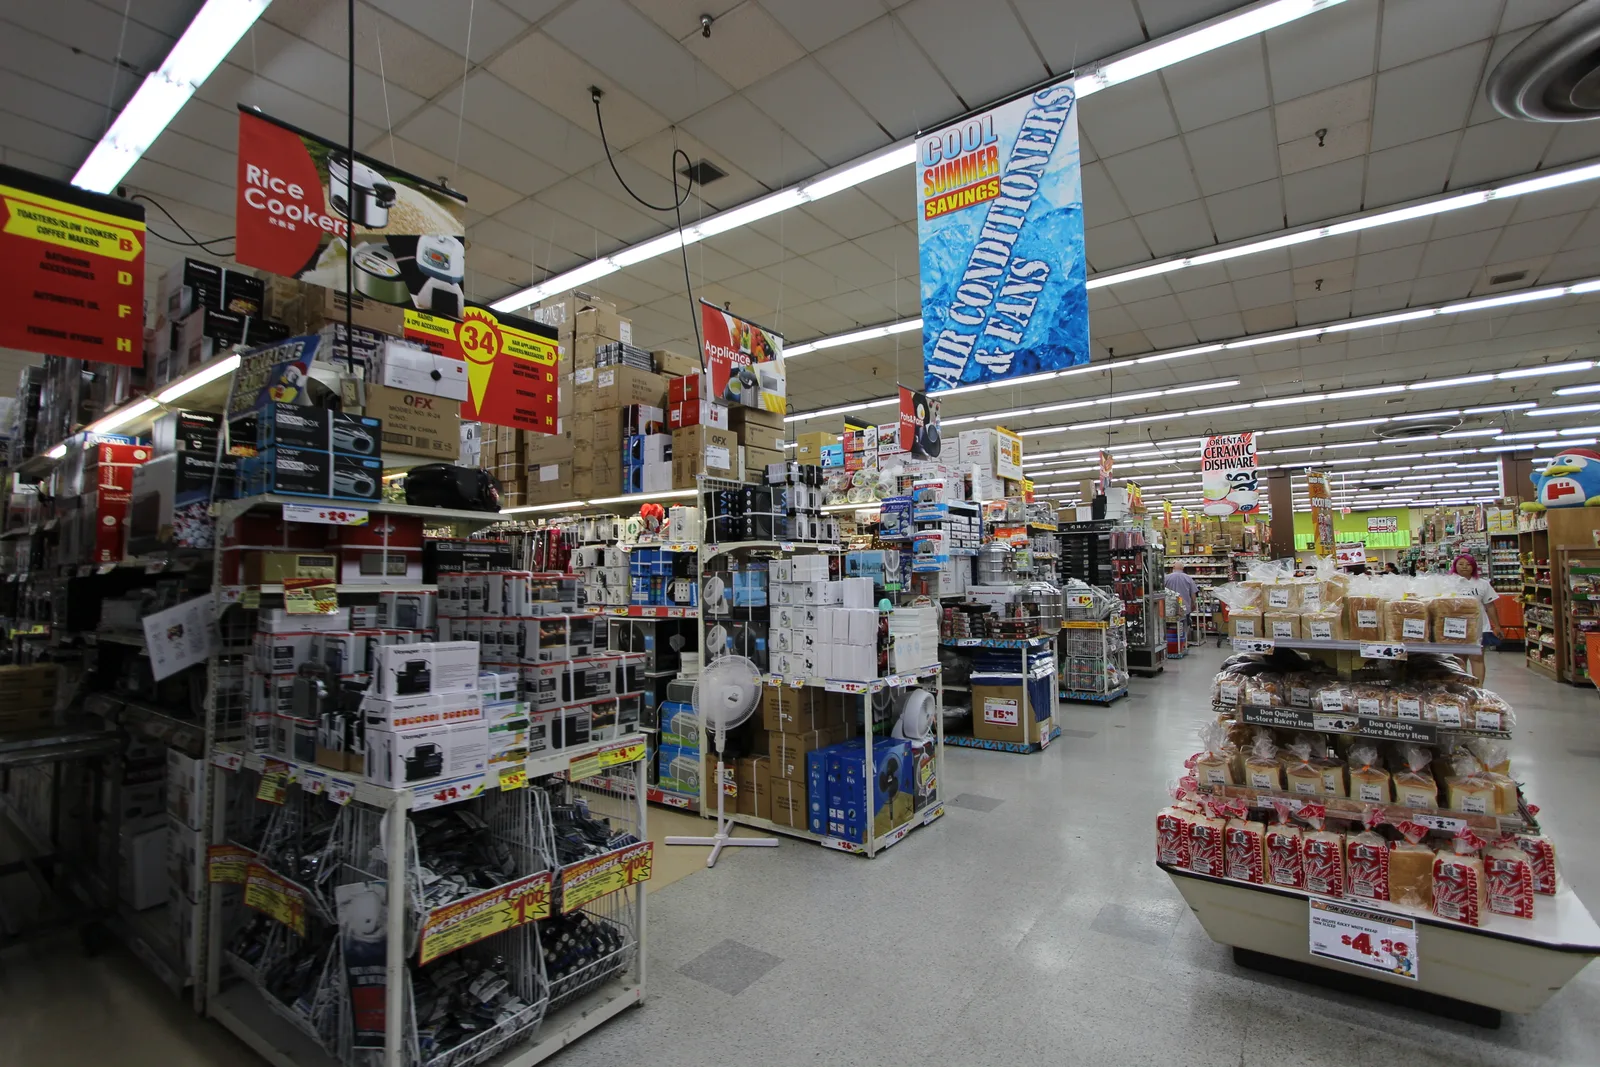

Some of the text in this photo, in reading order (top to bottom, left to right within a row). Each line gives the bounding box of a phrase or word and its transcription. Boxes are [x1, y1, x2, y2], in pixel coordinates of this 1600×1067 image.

[921, 114, 998, 168] COOL
[923, 145, 999, 198] SUMMER
[246, 163, 305, 200] Rice
[926, 178, 999, 218] SAVINGS
[244, 187, 350, 237] Cookers
[37, 225, 100, 248] COFFEE MAKERS
[83, 225, 119, 241] COOKERS
[926, 86, 1076, 389] AIR CONDITIONERS
[119, 238, 134, 252] B
[117, 270, 133, 286] D
[983, 257, 1050, 344] FANS
[117, 304, 132, 318] F
[116, 337, 132, 352] H
[463, 325, 495, 356] 34
[546, 352, 554, 361] B
[705, 339, 751, 367] Appliance
[546, 372, 554, 382] D
[546, 395, 553, 404] F
[181, 412, 214, 422] Panasonic
[545, 416, 553, 426] H
[388, 422, 408, 431] MADE
[418, 427, 438, 435] CHINA
[1209, 436, 1246, 447] ORIENTAL
[1203, 443, 1254, 459] CERAMIC
[1204, 456, 1255, 472] DISHWARE
[1246, 714, 1314, 728] In-Store Bakery Item
[1260, 708, 1299, 720] Don Quijote
[1368, 719, 1413, 732] Don Quijote
[1383, 729, 1411, 740] Bakery
[1411, 732, 1429, 741] Item
[1252, 831, 1264, 885] SHOKUPAN
[1331, 841, 1343, 899] SHOKUPAN
[1466, 866, 1479, 927] SHOKUPAN
[1522, 861, 1534, 919] SHOKUPAN
[1369, 913, 1397, 924] BAKERY
